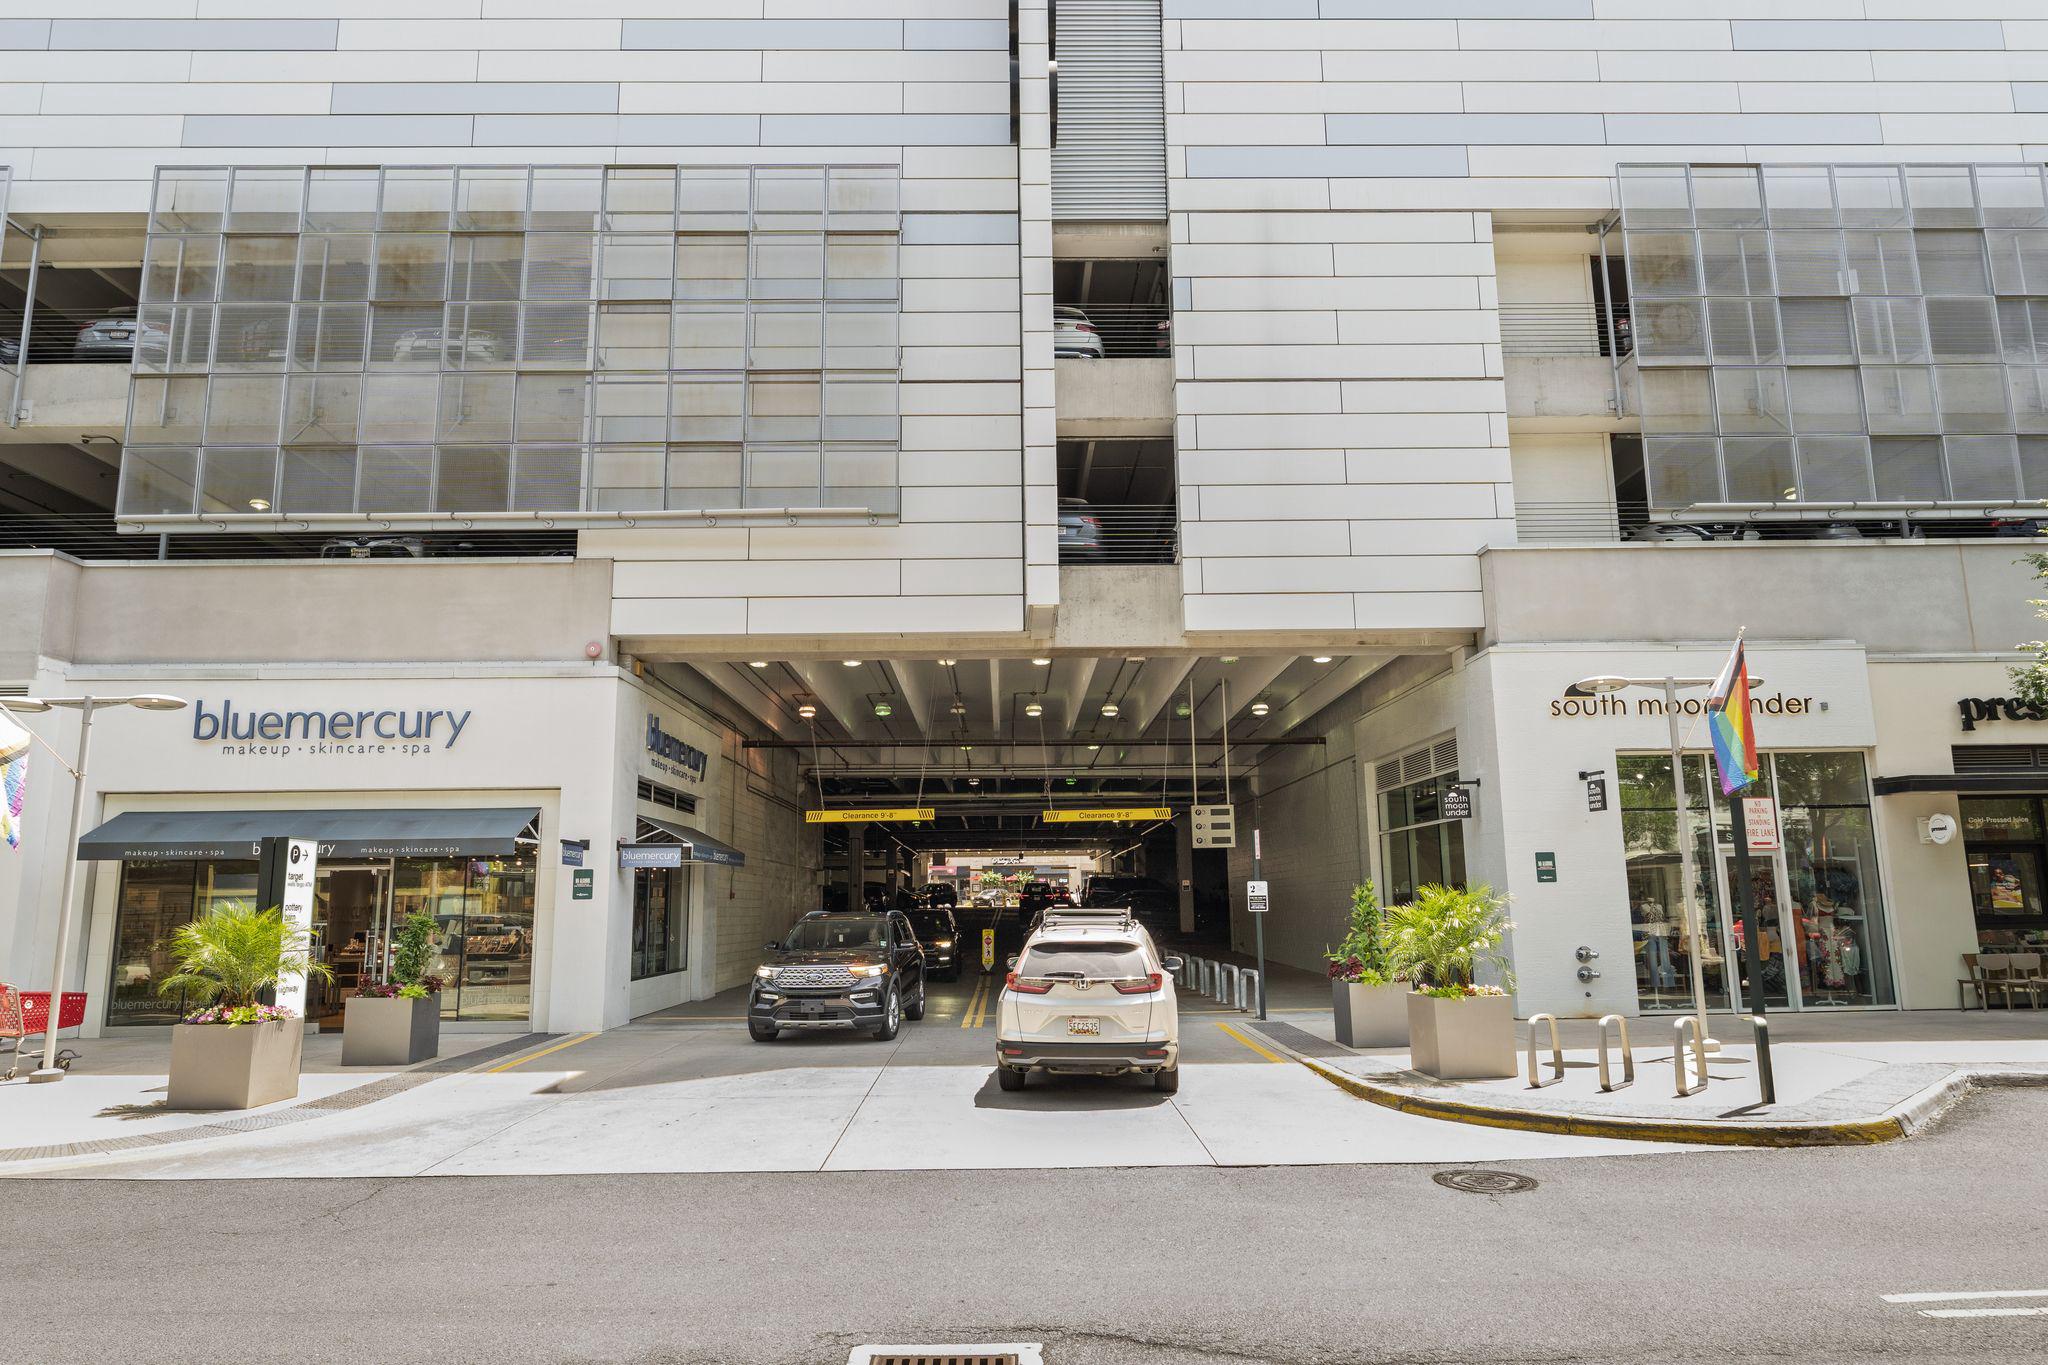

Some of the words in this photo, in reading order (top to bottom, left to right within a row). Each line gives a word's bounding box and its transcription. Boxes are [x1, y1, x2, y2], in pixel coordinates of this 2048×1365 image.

[1550, 694, 1627, 716] south
[1638, 698, 1710, 716] moo
[1749, 692, 1813, 714] nder
[193, 699, 472, 750] bluemercury
[222, 742, 291, 758] makeup
[309, 741, 386, 755] skincare
[401, 744, 431, 757] spa
[645, 712, 709, 783] bluemercury
[651, 757, 669, 775] makeup
[670, 764, 689, 781] skincare
[689, 774, 697, 785] spa
[1444, 795, 1468, 803] south
[1754, 800, 1762, 808] NO
[842, 812, 878, 820] Clearance
[1078, 811, 1115, 819] Clearance
[1445, 809, 1469, 817] under
[1748, 807, 1768, 815] PARKING
[1748, 818, 1771, 826] STANDING
[1746, 828, 1760, 837] FIRE
[1760, 828, 1775, 838] LANE
[124, 848, 159, 858] makeup
[165, 848, 203, 857] skincare
[210, 848, 226, 858] spa
[360, 846, 395, 854] makeup
[400, 845, 439, 854] skincare
[445, 845, 461, 855] spa
[622, 849, 680, 862] bluemercury
[288, 872, 304, 882] target
[1250, 885, 1256, 893] 2
[284, 904, 303, 913] pottery
[111, 999, 181, 1010] bluemercury
